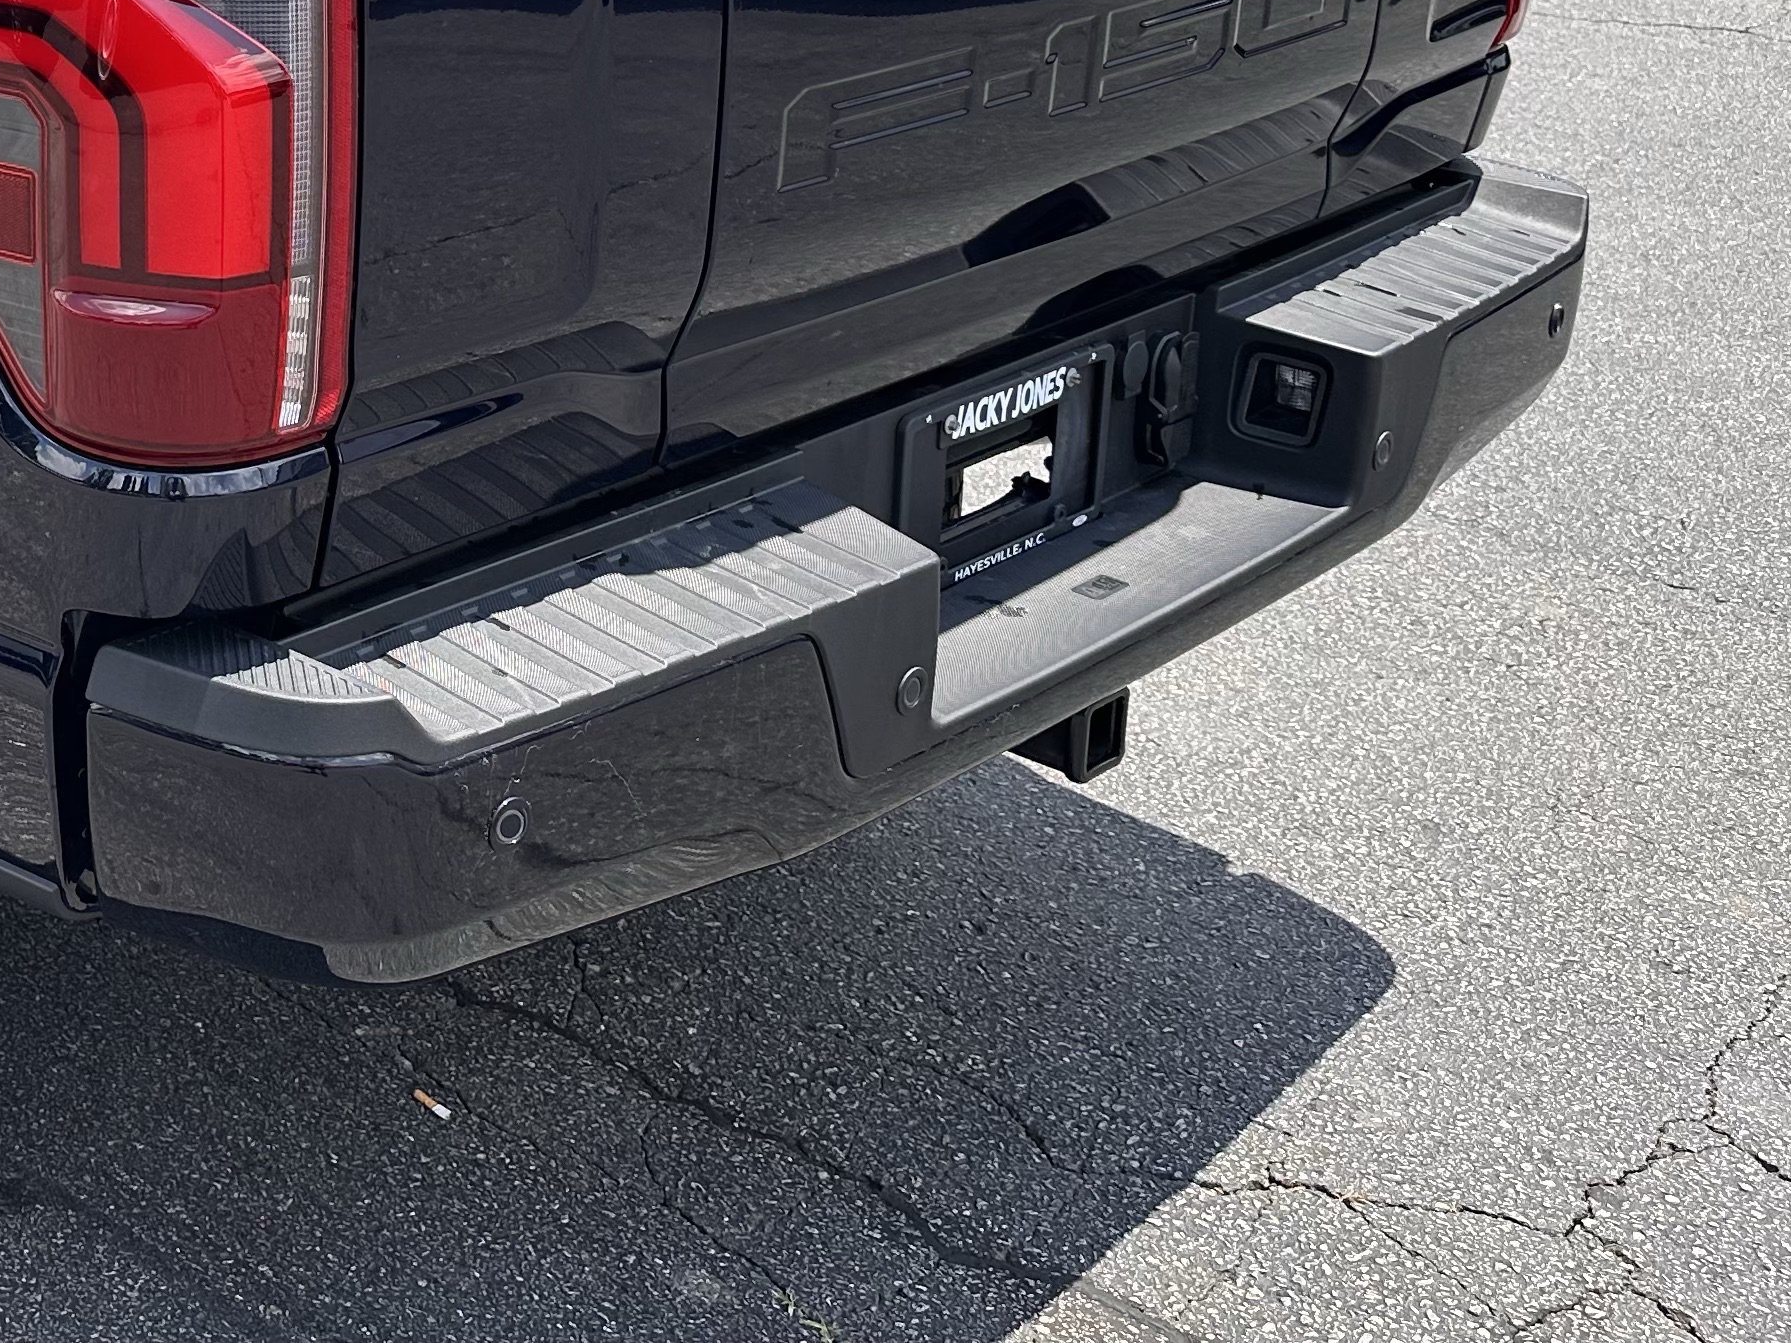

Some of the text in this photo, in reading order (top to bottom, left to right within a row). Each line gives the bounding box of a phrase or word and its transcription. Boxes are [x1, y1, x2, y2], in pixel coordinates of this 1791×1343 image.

[951, 366, 1067, 440] JACKY JONES
[954, 532, 1047, 582] HAYESVILLE, N.C.
